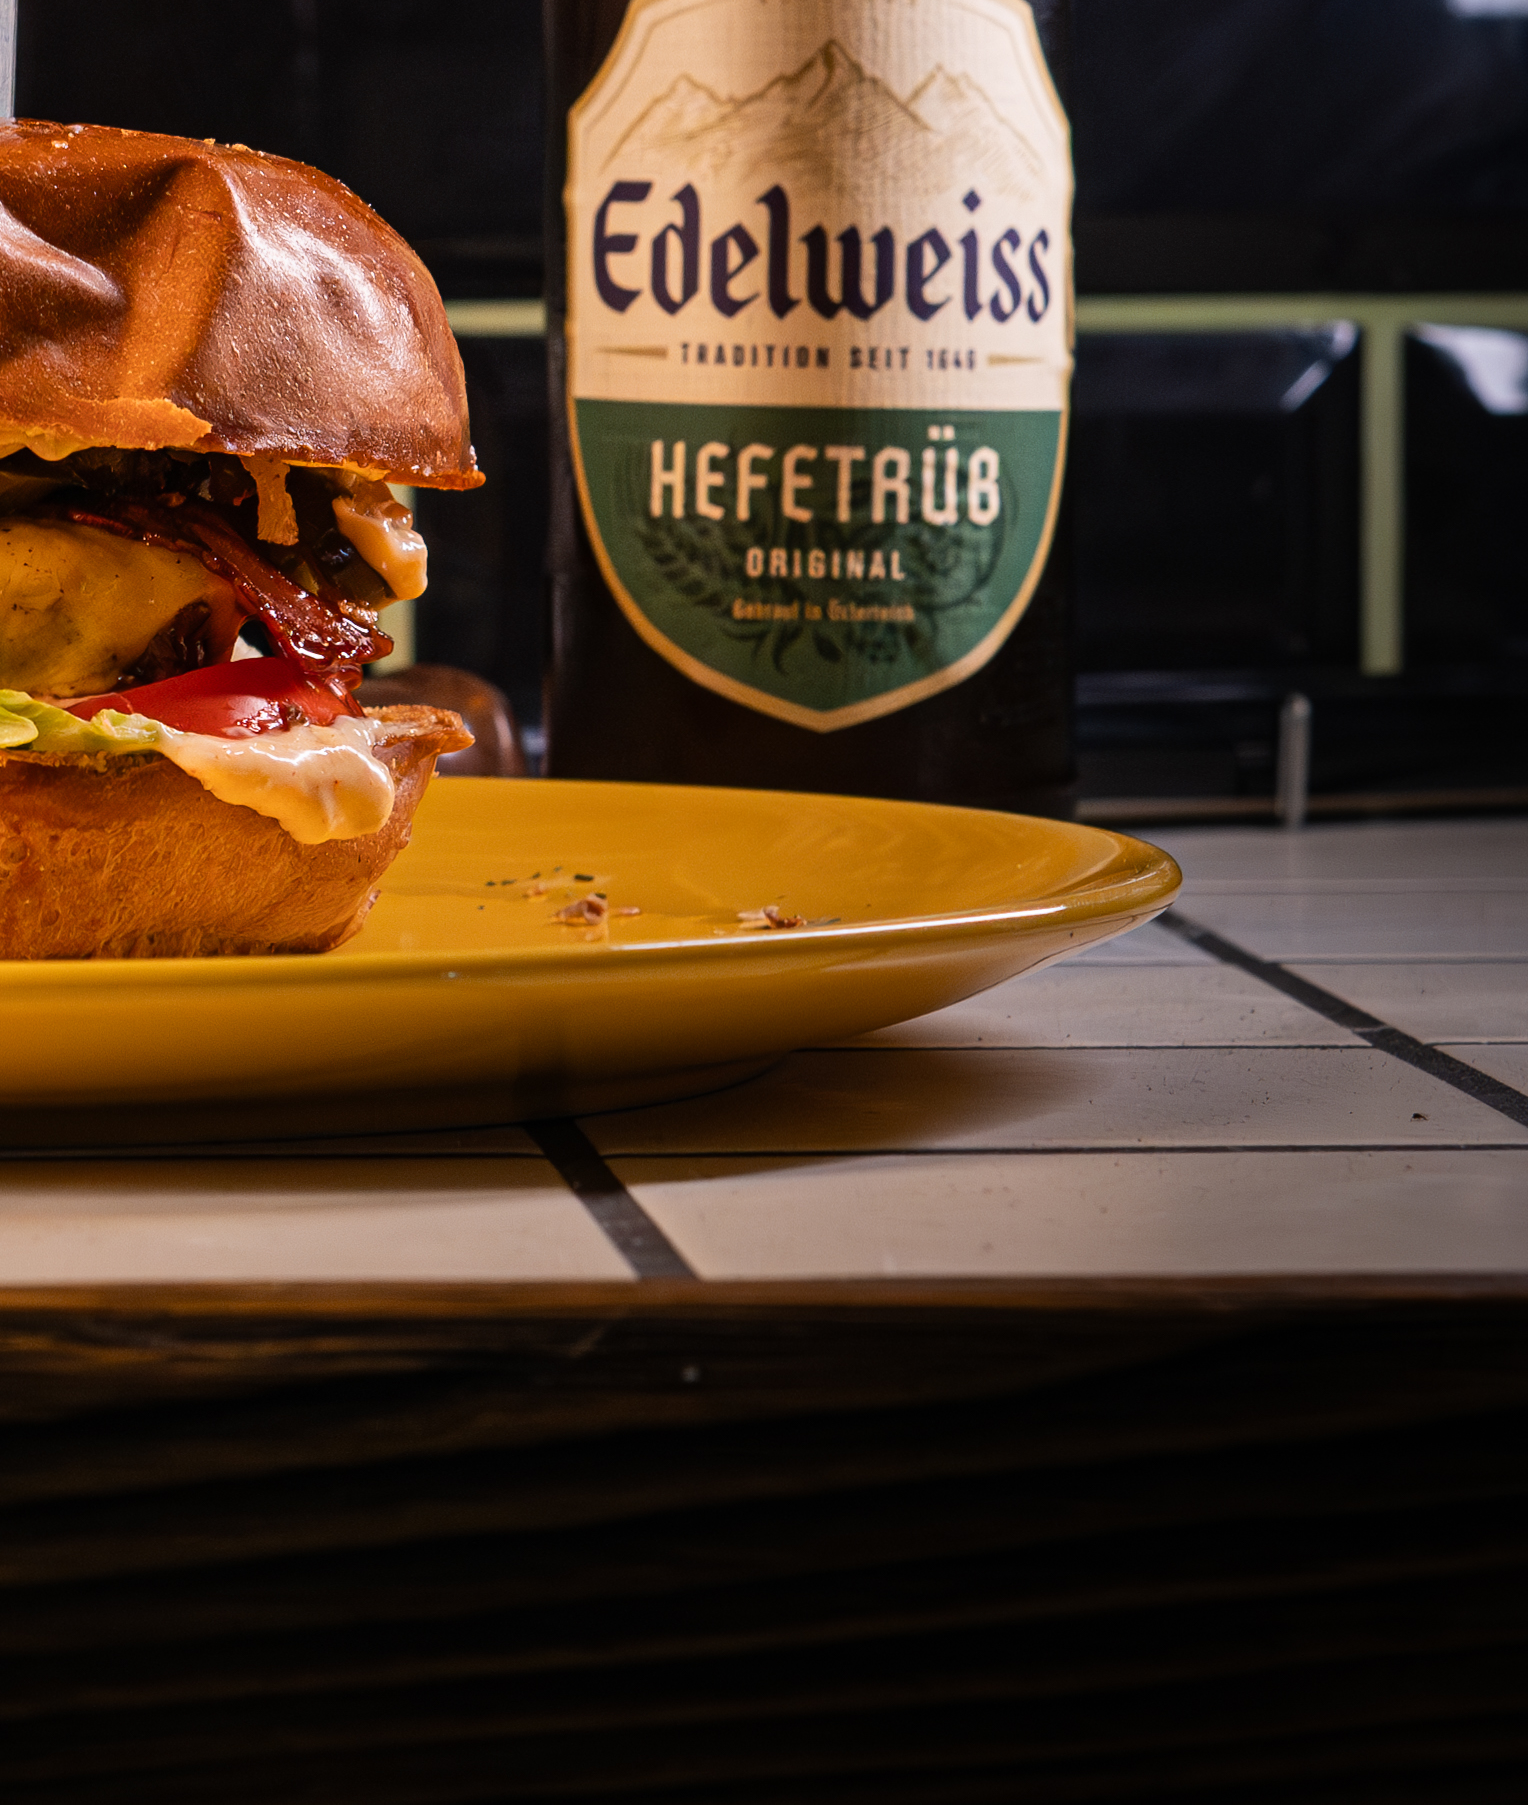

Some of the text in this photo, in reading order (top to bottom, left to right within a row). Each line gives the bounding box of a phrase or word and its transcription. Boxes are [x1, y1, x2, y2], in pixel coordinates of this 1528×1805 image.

[593, 180, 1050, 324] Edelweiss
[681, 341, 830, 370] TRADITION
[849, 345, 910, 371] SEIT
[649, 424, 1001, 527] HEFETRÜB
[745, 546, 906, 582] ORIGINAL
